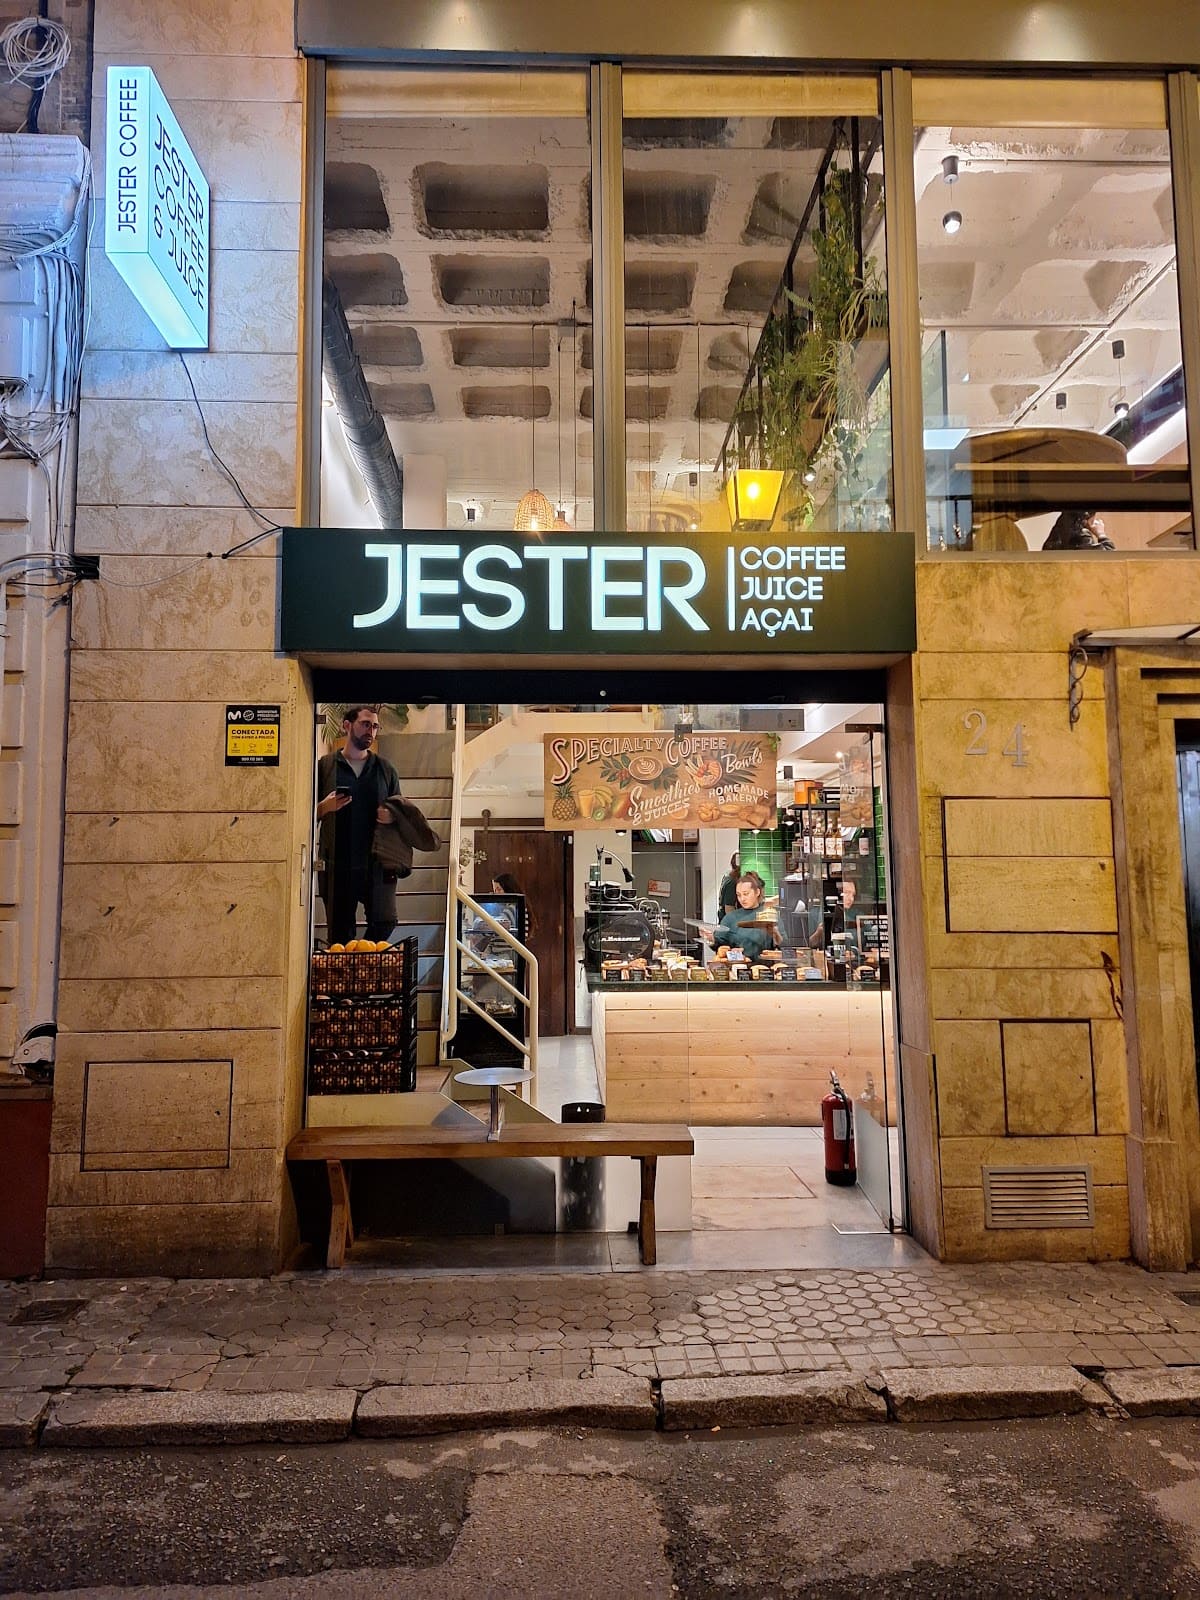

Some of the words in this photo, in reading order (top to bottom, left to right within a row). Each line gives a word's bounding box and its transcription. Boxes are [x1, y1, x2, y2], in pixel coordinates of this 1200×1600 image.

[119, 79, 138, 157] COFFEE
[154, 114, 204, 235] JESTER
[118, 165, 137, 234] JESTER
[154, 164, 204, 273] COFFEE
[168, 228, 204, 310] JUICE
[740, 546, 846, 570] COFFEE
[352, 543, 711, 632] JESTER
[740, 576, 824, 600] JUICE
[740, 607, 814, 637] AÇAI
[963, 709, 1030, 767] 24
[550, 737, 665, 785] SPECIALTY
[665, 736, 727, 766] COFFEE
[720, 746, 763, 774] Bowls
[628, 779, 701, 817] Smoothies
[644, 797, 690, 822] JUICES
[709, 783, 769, 799] HOMEMADE
[718, 792, 758, 805] BAKERY
